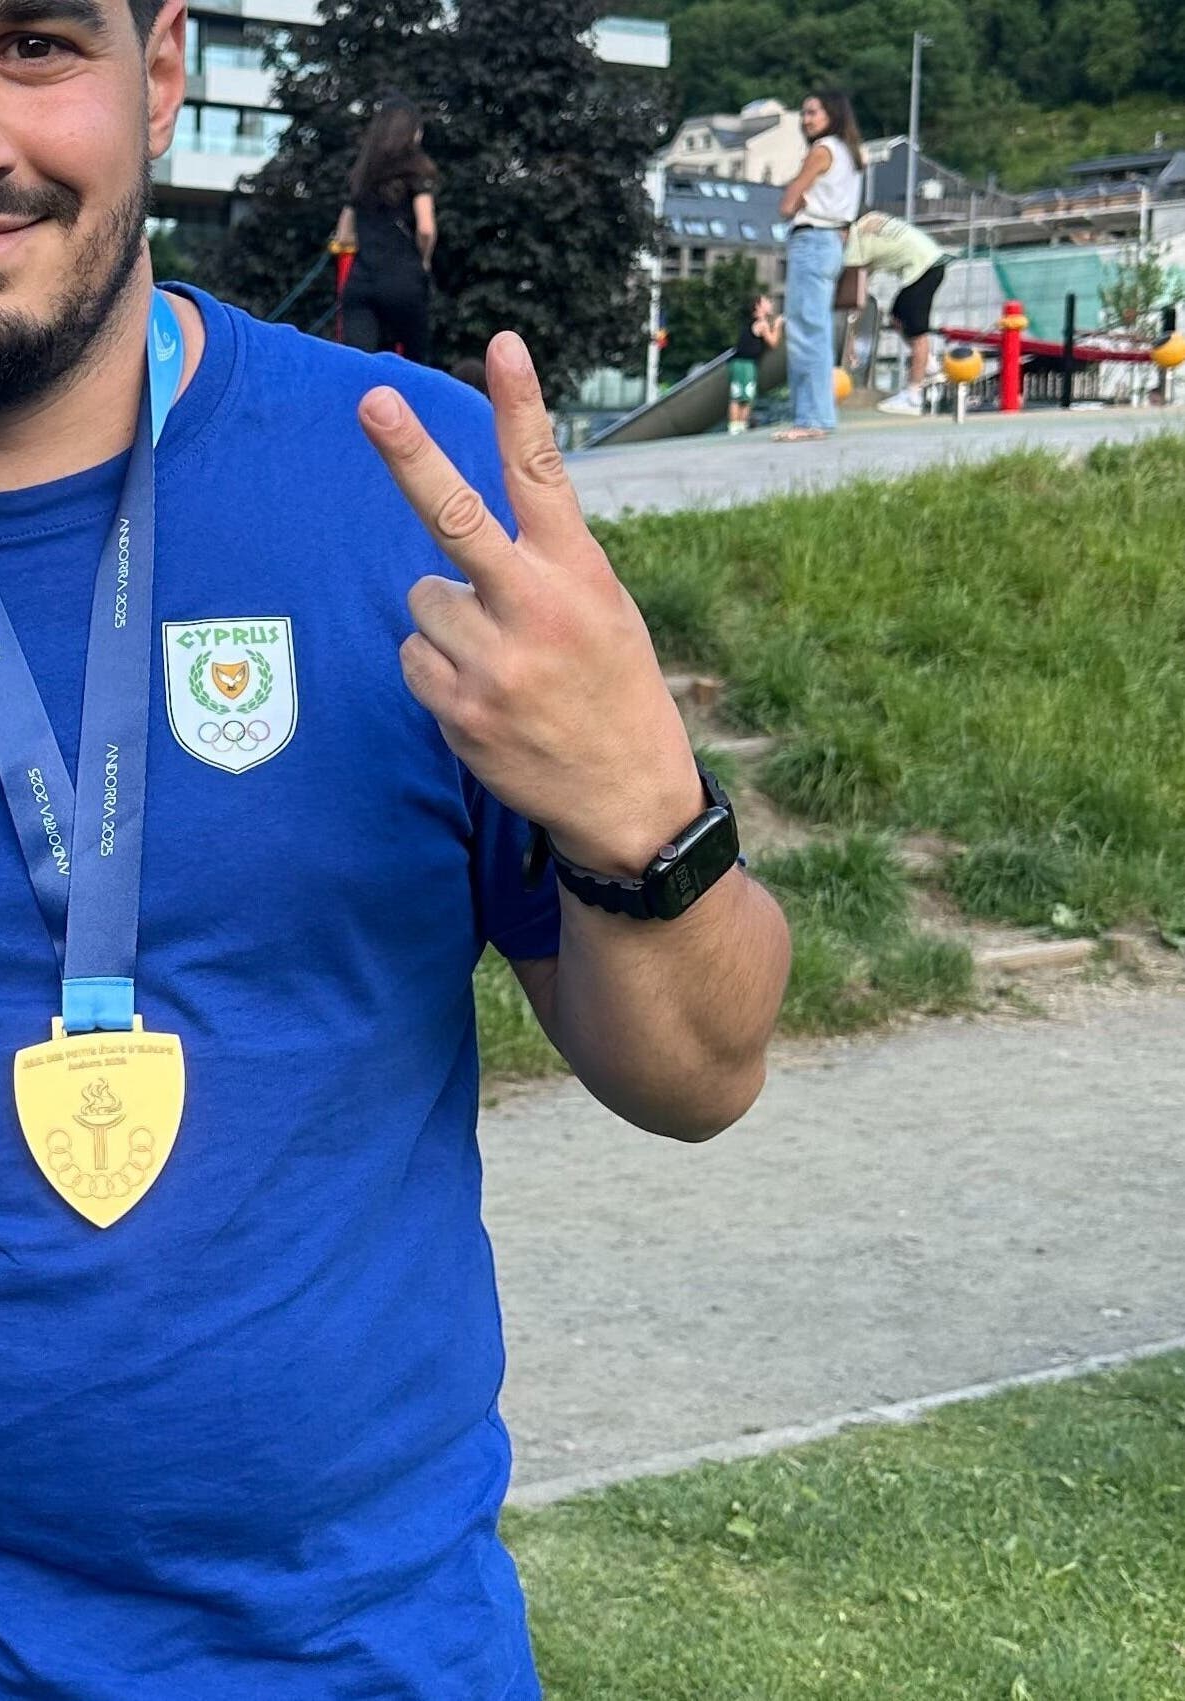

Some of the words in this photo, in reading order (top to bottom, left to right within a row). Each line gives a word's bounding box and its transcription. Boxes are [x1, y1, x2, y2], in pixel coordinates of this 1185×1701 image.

[117, 518, 130, 592] ANDORRA
[115, 593, 128, 628] 2025
[176, 626, 280, 649] CYPRUS
[27, 768, 49, 802] 2025
[103, 743, 118, 819] ANDORRA
[40, 804, 70, 875] ANDORRA
[100, 821, 115, 857] 2025
